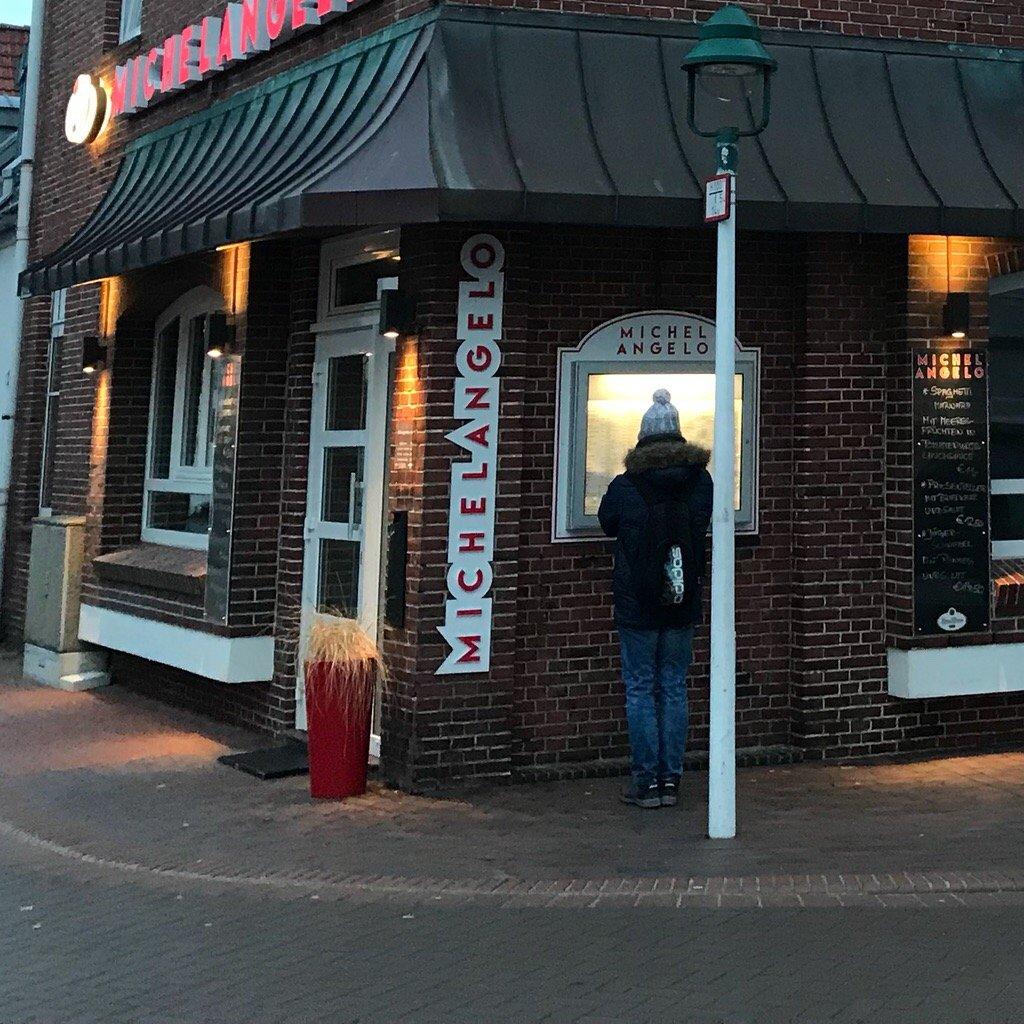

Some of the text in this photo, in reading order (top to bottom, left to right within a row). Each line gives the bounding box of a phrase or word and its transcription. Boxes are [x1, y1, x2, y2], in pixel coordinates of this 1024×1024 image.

[620, 325, 707, 339] MICHEL
[616, 342, 709, 355] ANGELO
[917, 353, 983, 366] MICHEL
[915, 366, 985, 379] ANGELO
[452, 241, 498, 667] MICHELANGELO
